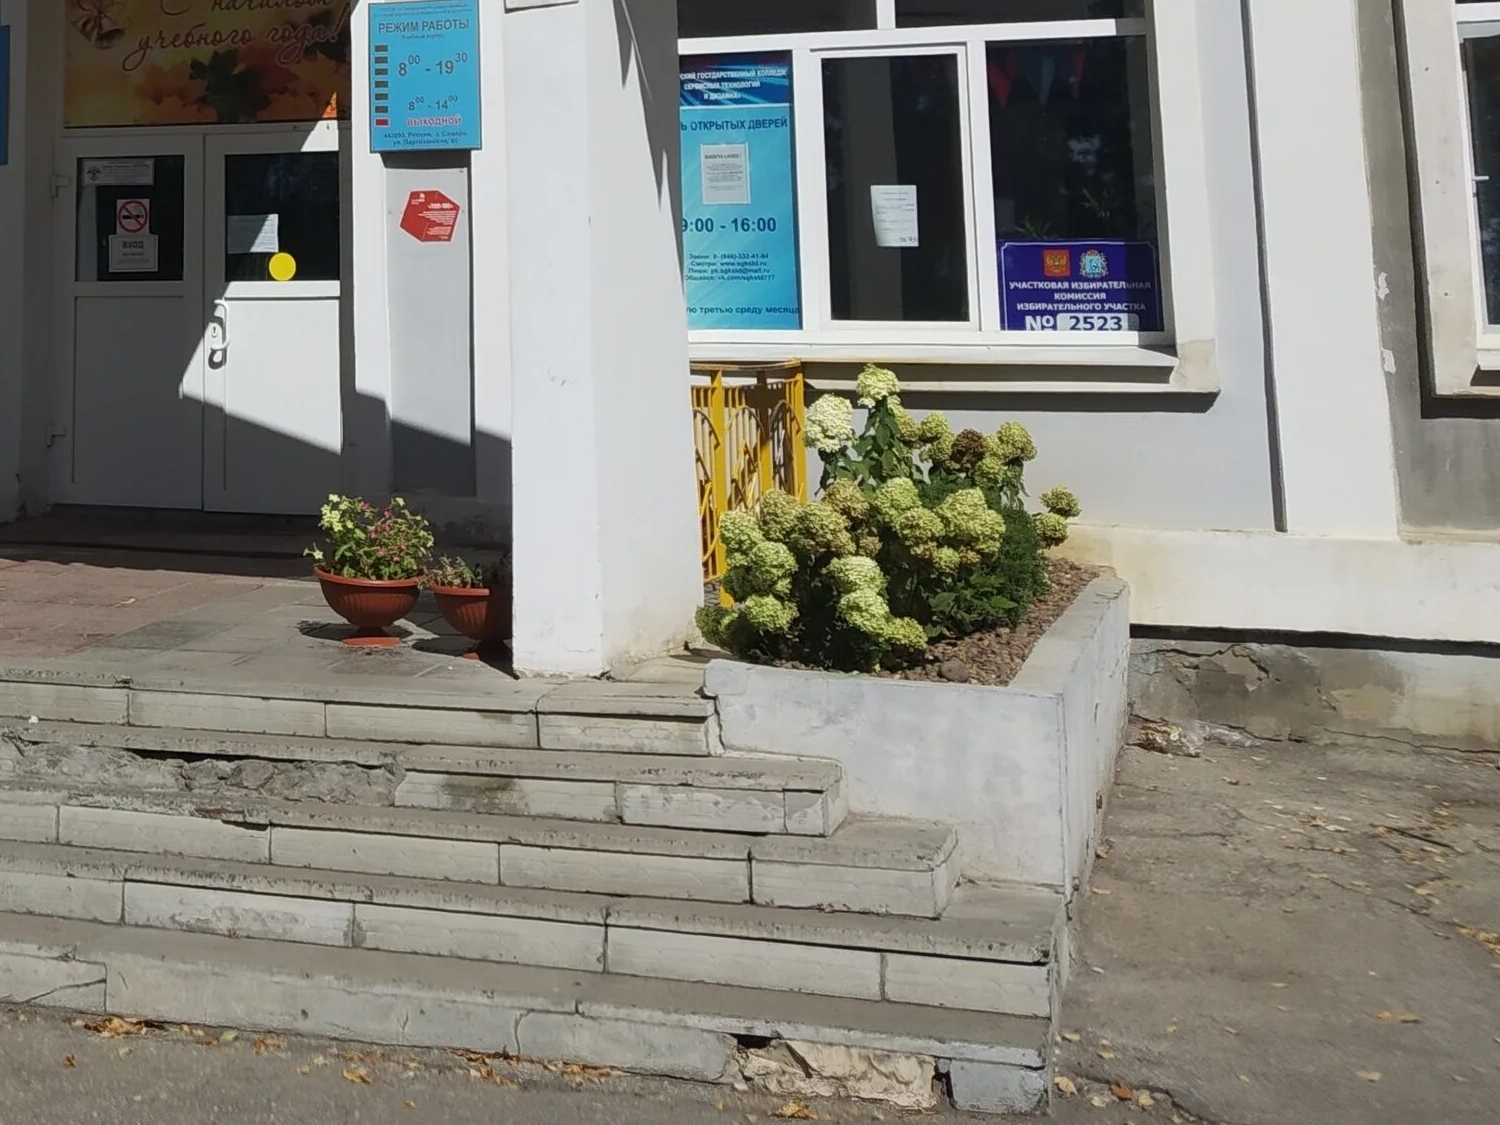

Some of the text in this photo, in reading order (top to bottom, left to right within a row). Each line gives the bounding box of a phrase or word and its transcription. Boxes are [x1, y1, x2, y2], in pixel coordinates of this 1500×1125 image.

[378, 19, 470, 33] РЕЖИМ РАБОТЫ
[122, 22, 255, 72] учебного
[407, 115, 461, 126] ВЫХОДНОЙ
[690, 119, 746, 131] ОТКРЫТЫХ
[748, 116, 788, 130] ДВЕРЕЙ
[731, 217, 777, 233] 16:00
[1009, 281, 1151, 290] УЧАСТКОВАЯ ИЗБИРАТЕЛЬНАЯ
[1054, 292, 1107, 300] КОМИССИЯ
[700, 307, 733, 315] третью
[735, 307, 763, 315] среду
[1016, 302, 1146, 311] ИЗБИРАТЕЛЬНОГО УЧАСТКА
[1069, 316, 1122, 331] 2523
